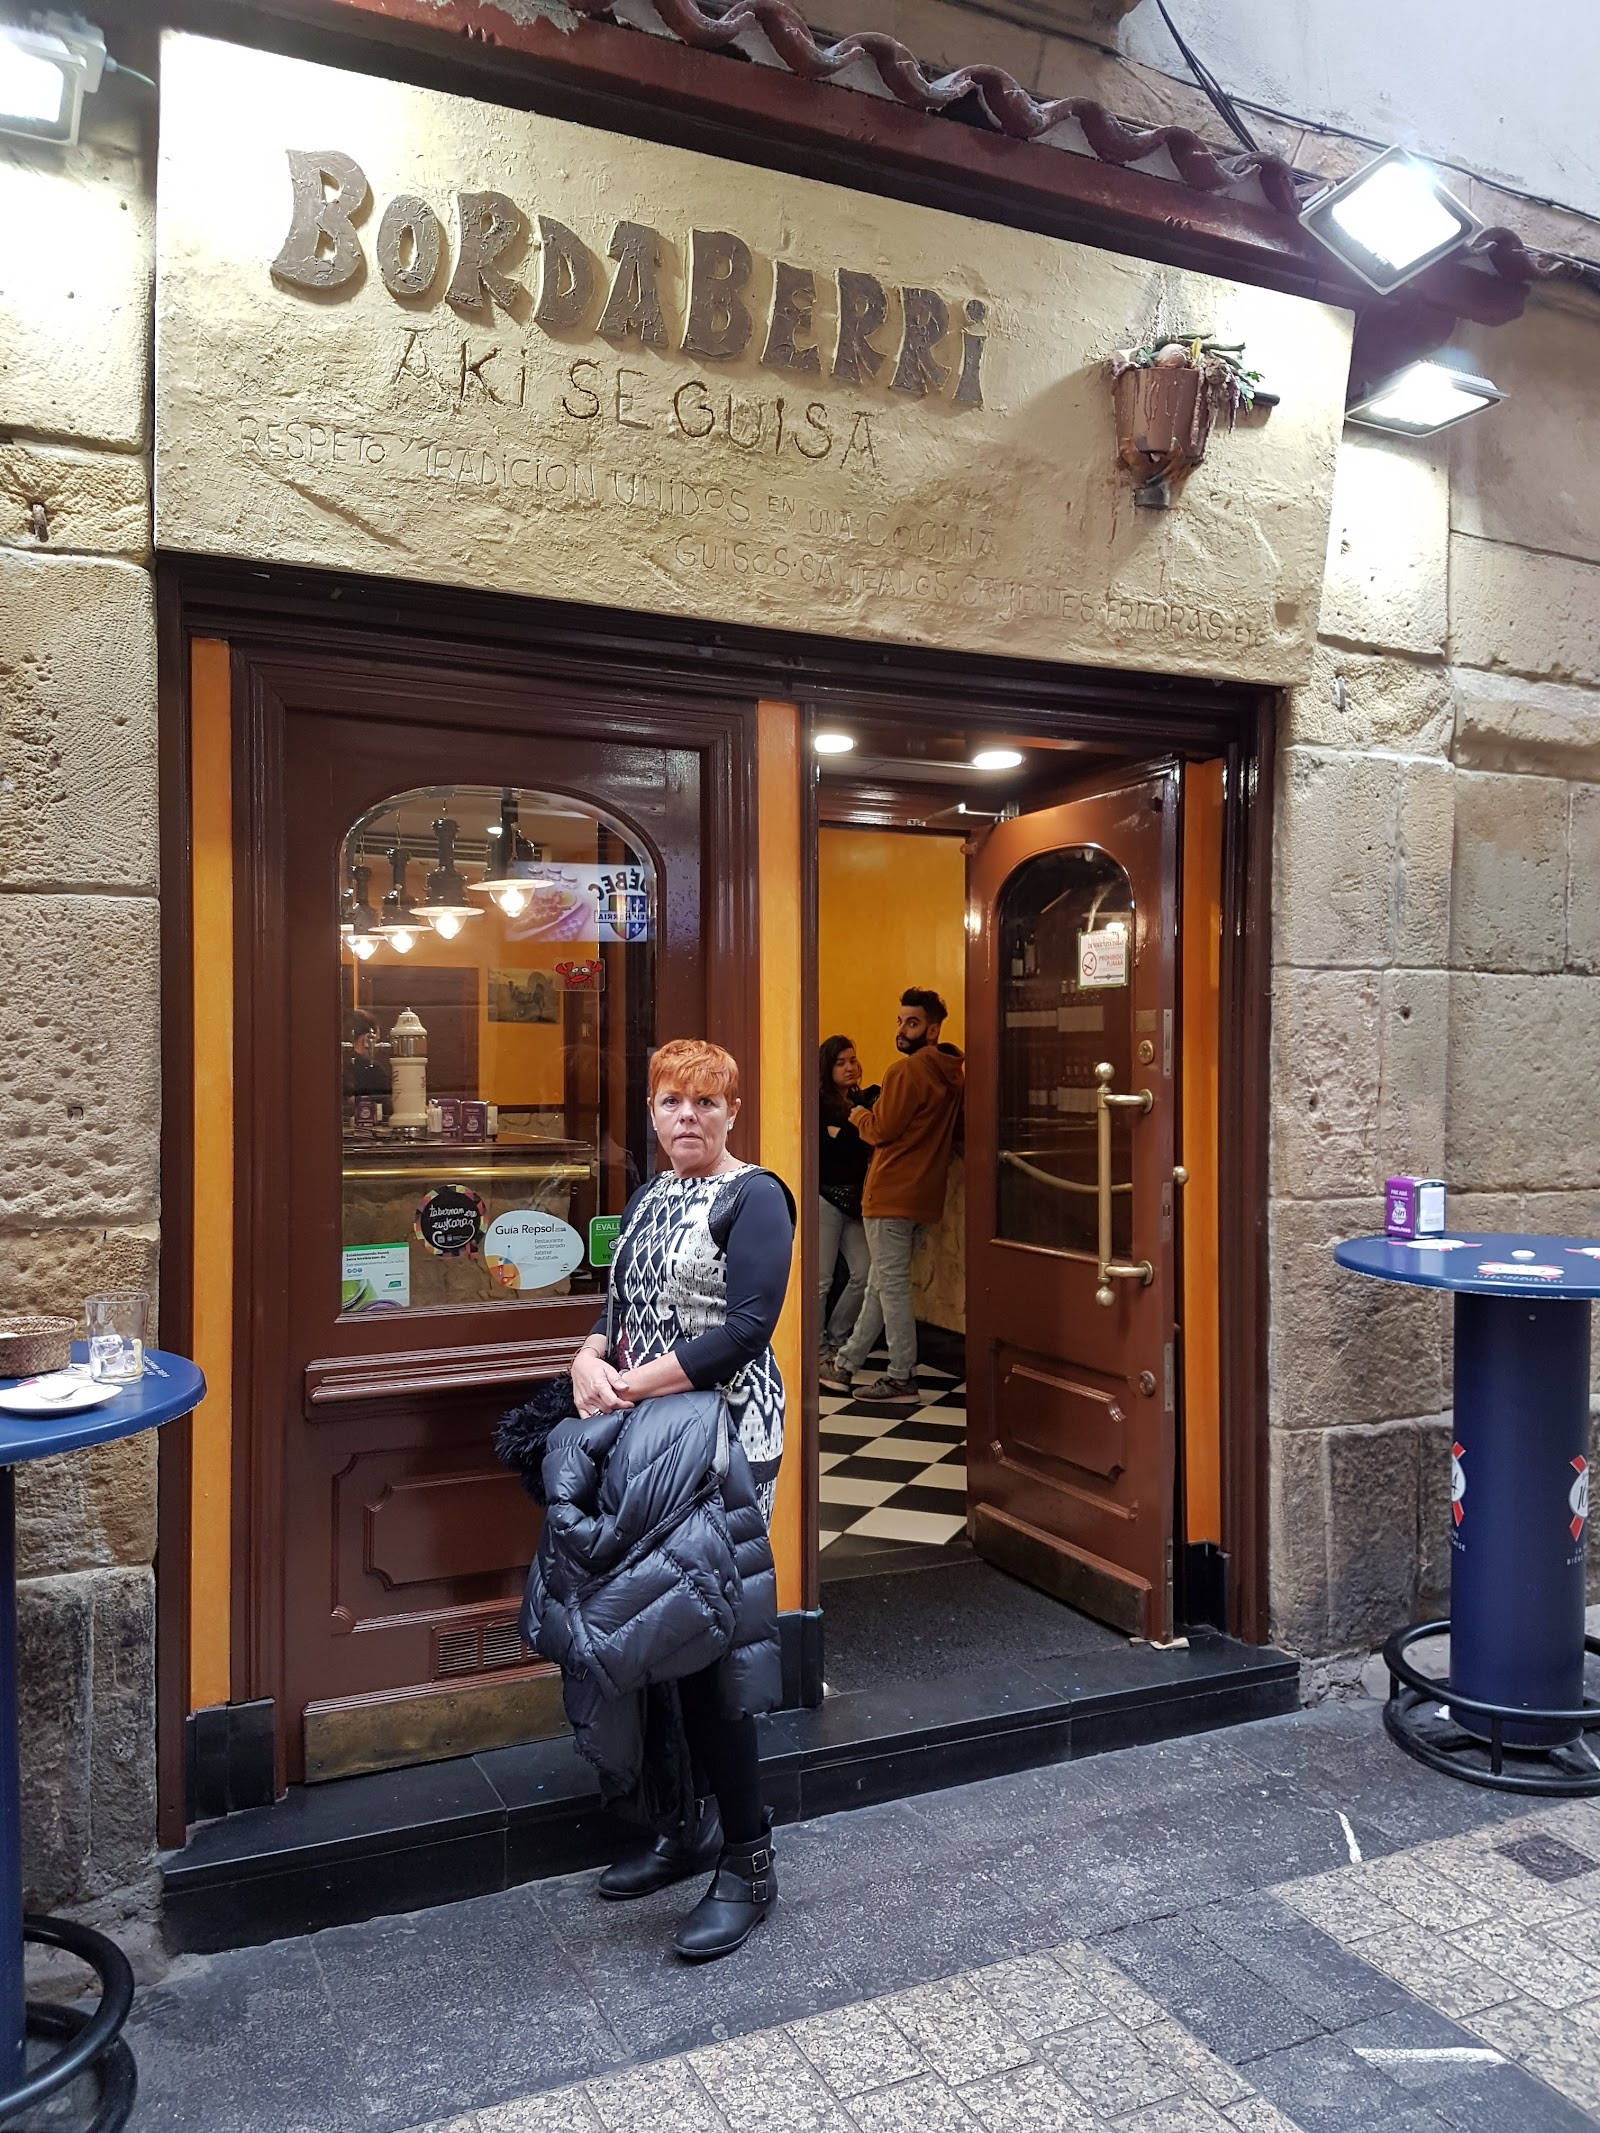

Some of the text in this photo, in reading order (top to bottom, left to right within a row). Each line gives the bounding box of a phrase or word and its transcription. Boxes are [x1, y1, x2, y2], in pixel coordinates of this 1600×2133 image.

[561, 357, 652, 430] SE
[672, 379, 880, 470] GUISA
[767, 495, 796, 514] EN
[495, 1225, 519, 1235] Guía
[521, 1223, 555, 1236] Repsol
